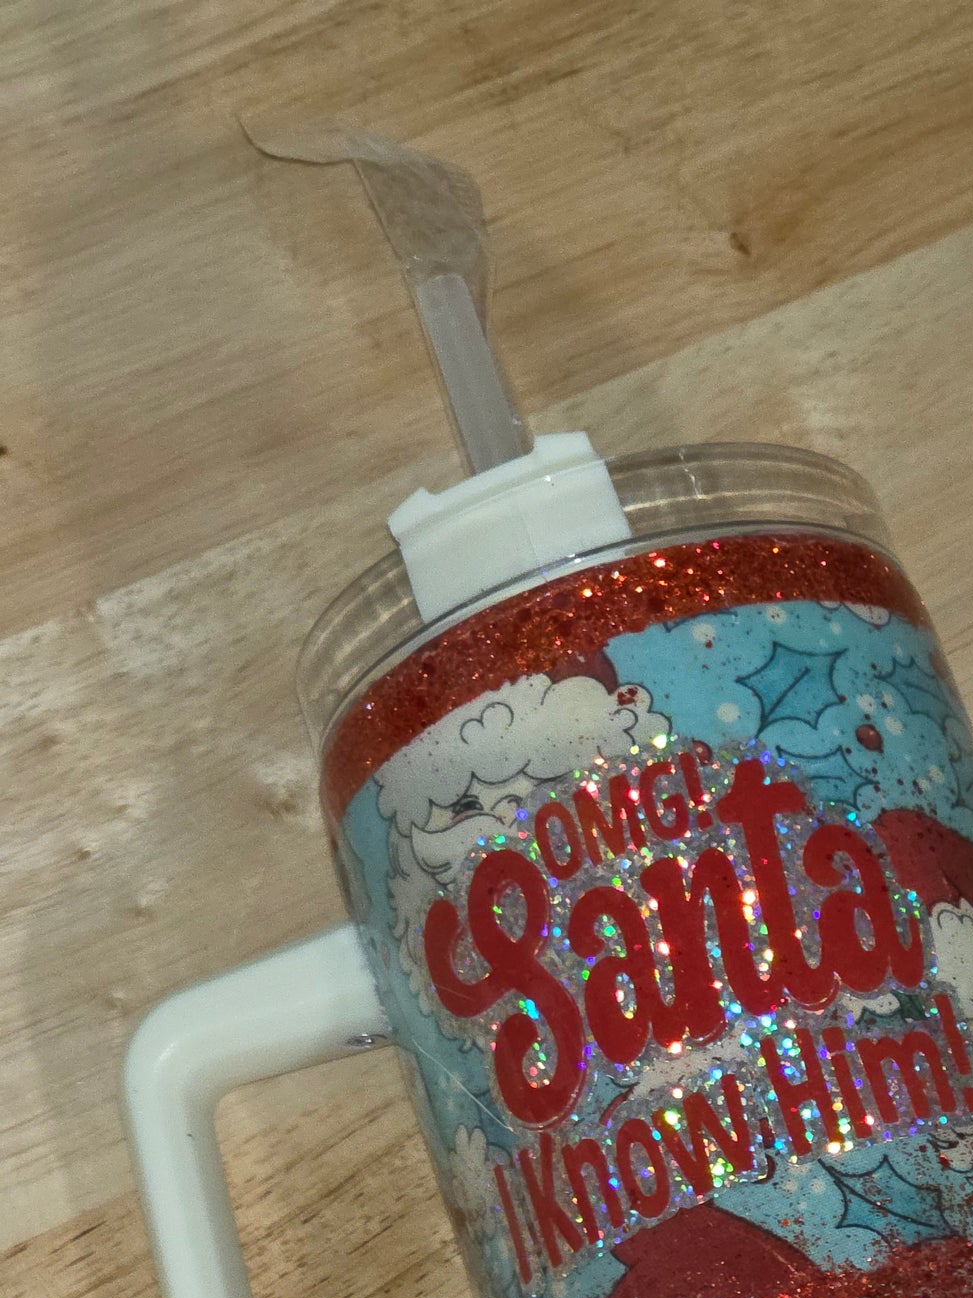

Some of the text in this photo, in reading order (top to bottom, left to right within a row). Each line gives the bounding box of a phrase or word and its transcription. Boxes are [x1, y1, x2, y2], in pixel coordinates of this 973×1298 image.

[534, 752, 712, 880] OMG!
[424, 758, 924, 1129] Santa
[494, 1164, 533, 1285] I
[519, 1073, 754, 1268] Know
